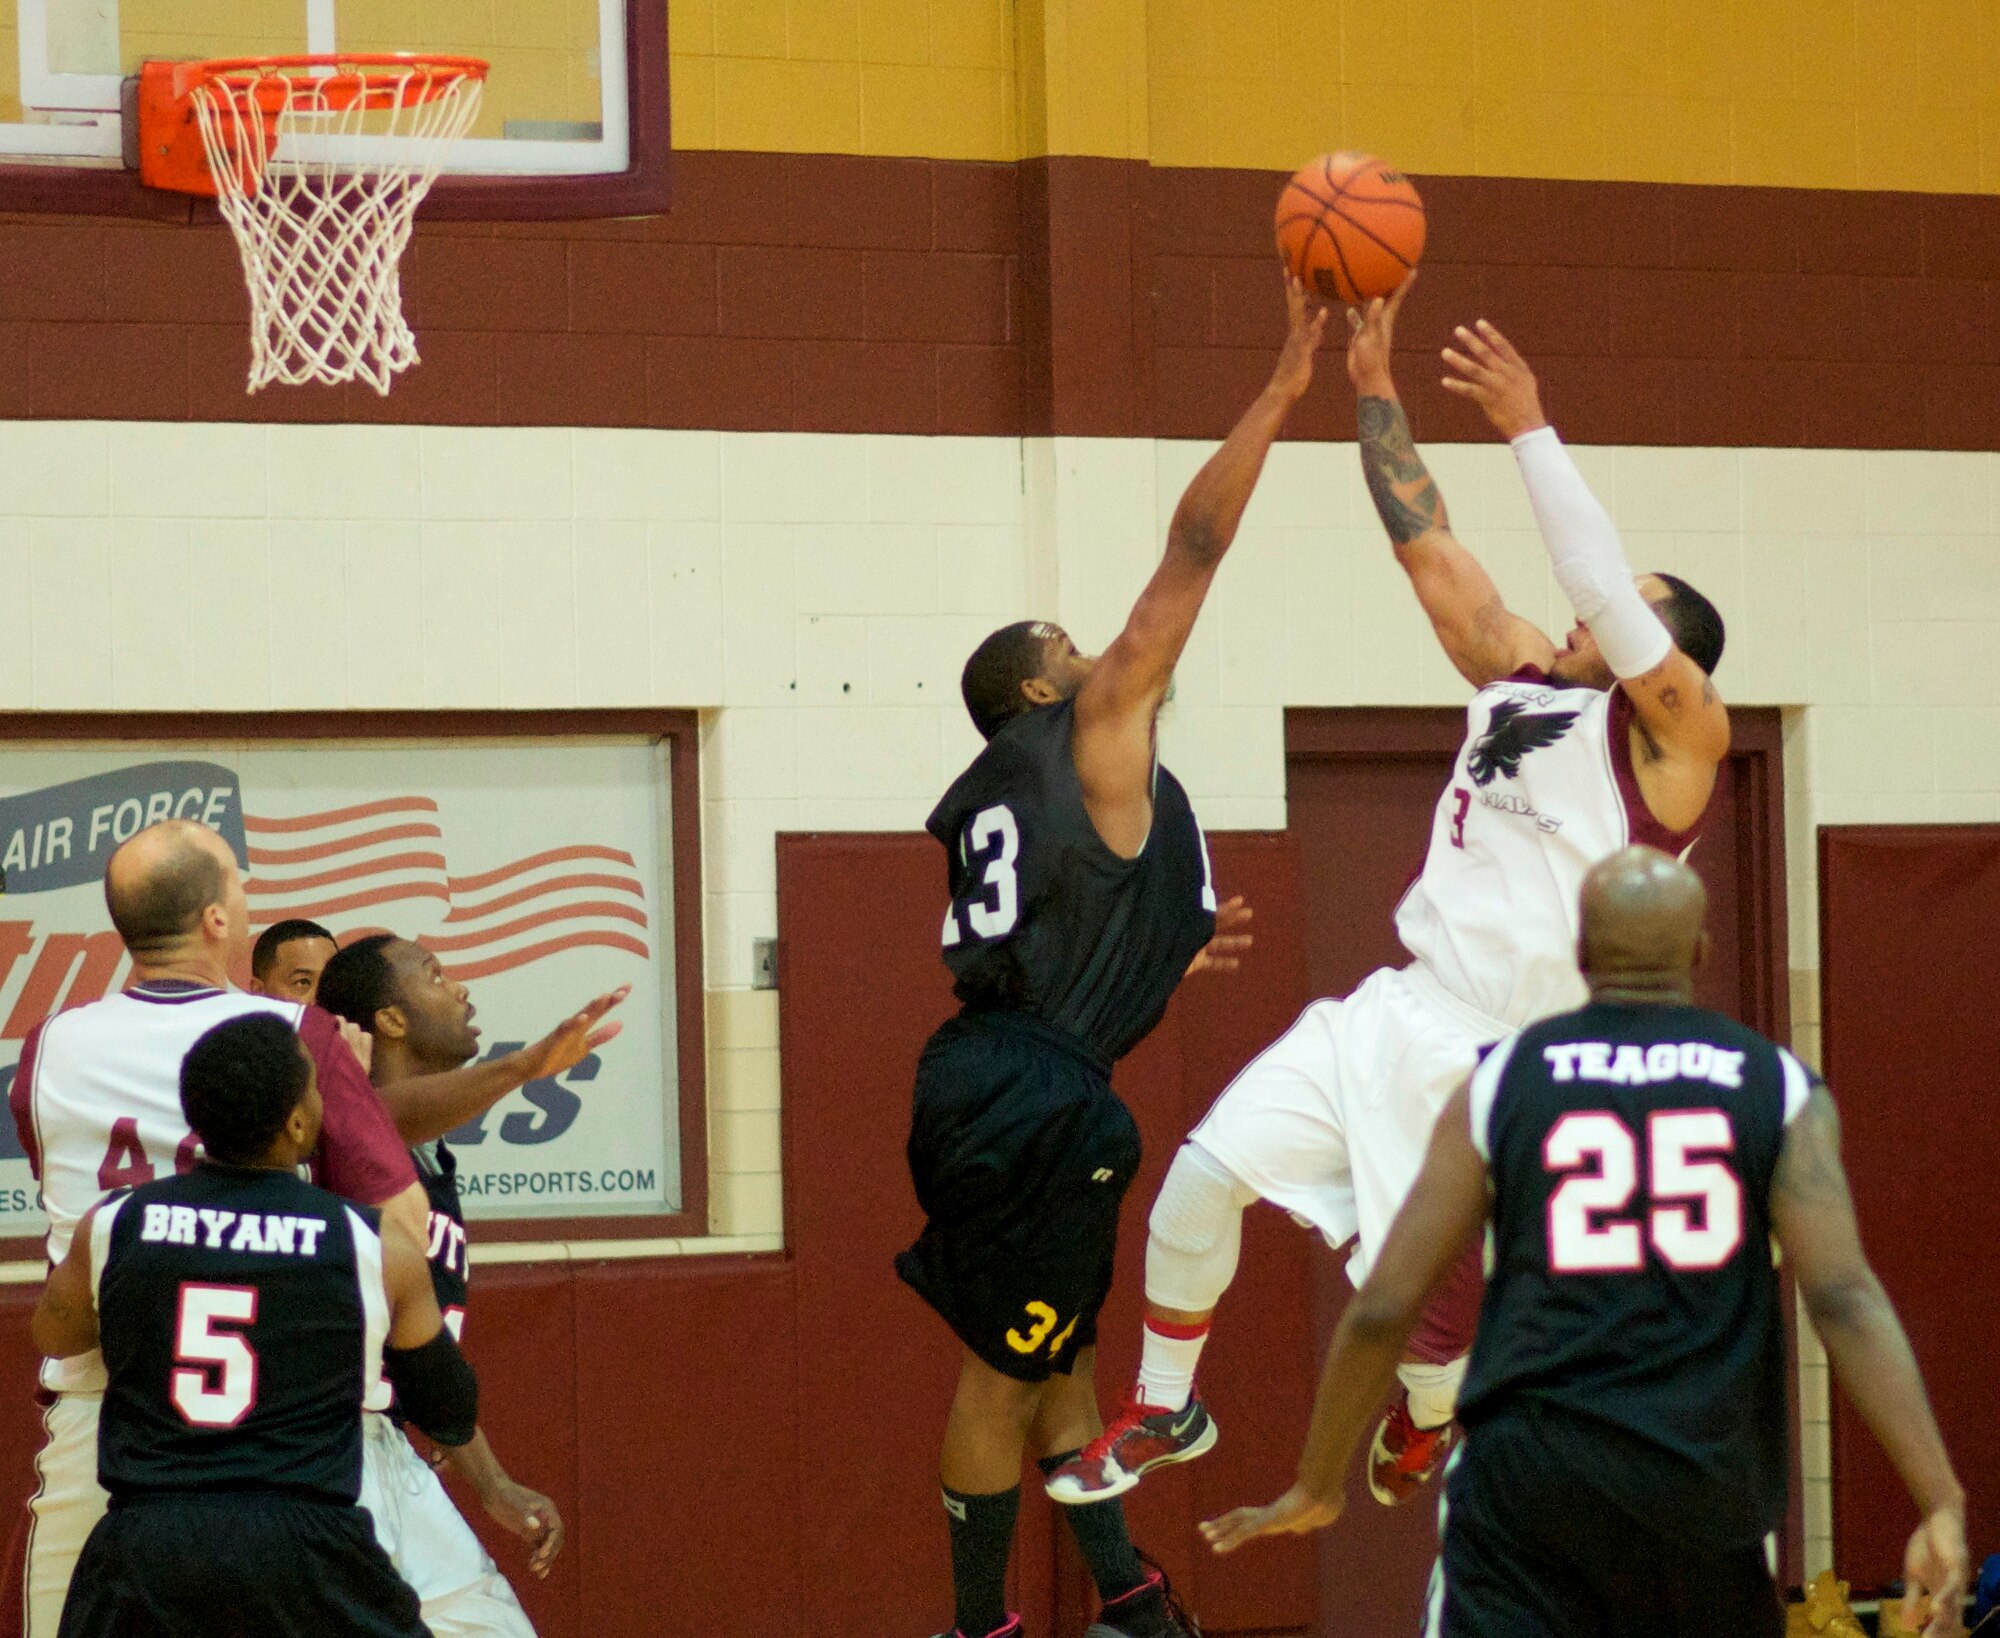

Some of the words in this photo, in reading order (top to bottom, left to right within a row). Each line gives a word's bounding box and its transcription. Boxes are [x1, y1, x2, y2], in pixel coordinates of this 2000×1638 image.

[3, 816, 74, 872] AIR
[88, 786, 234, 852] FORCE
[1544, 1041, 1746, 1089] TEAGUE
[141, 1203, 327, 1256] BRYANT
[1543, 1108, 1747, 1275] 25
[171, 1282, 258, 1428] 5
